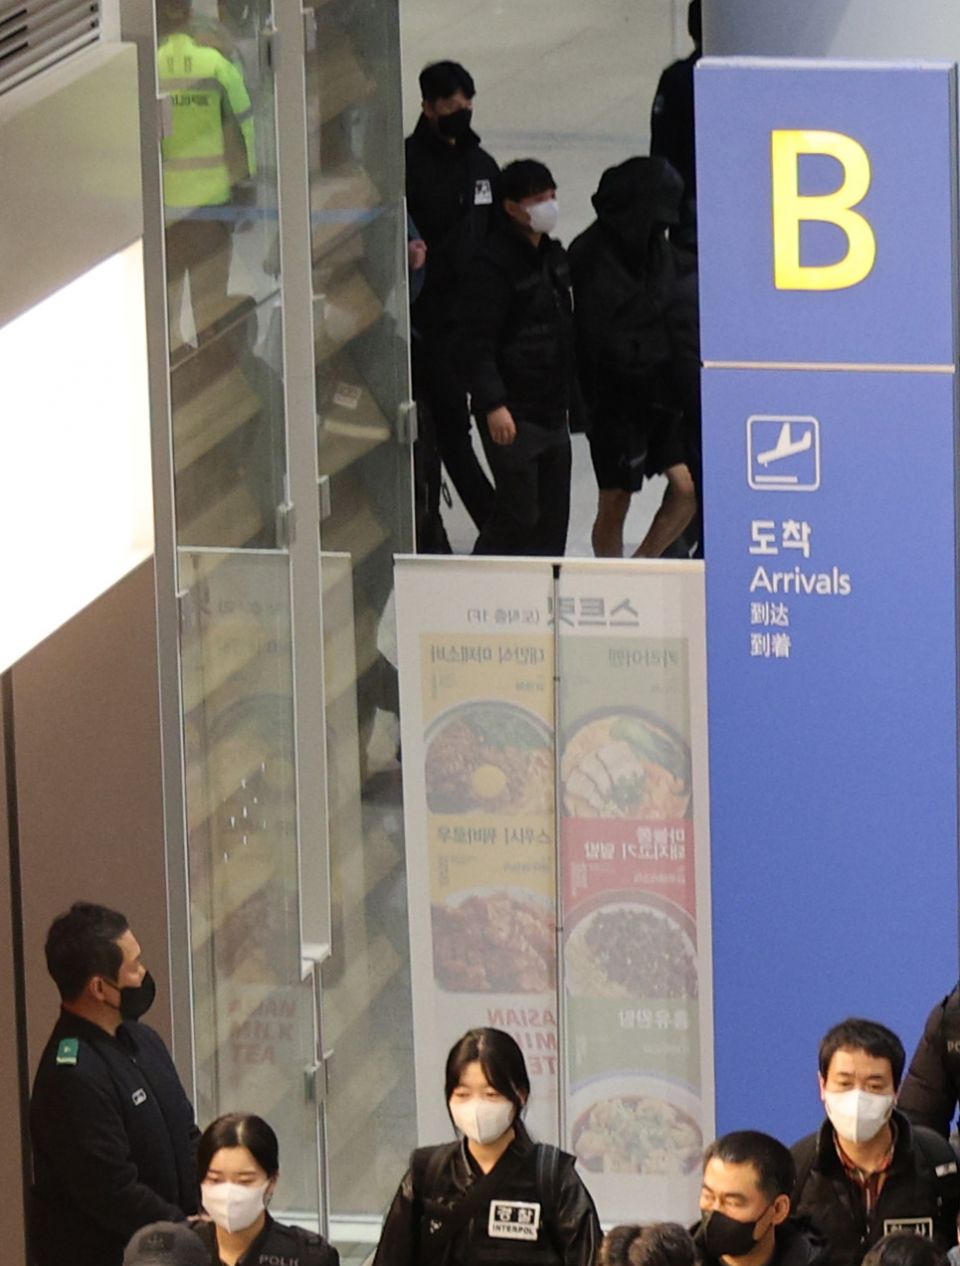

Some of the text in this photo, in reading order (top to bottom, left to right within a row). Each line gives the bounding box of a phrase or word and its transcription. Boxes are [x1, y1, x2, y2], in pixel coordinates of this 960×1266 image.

[771, 129, 876, 290] B
[749, 519, 812, 558] 도착
[750, 566, 852, 596] Arrivals
[750, 602, 789, 627] 到达
[491, 1222, 534, 1236] INTERPOL
